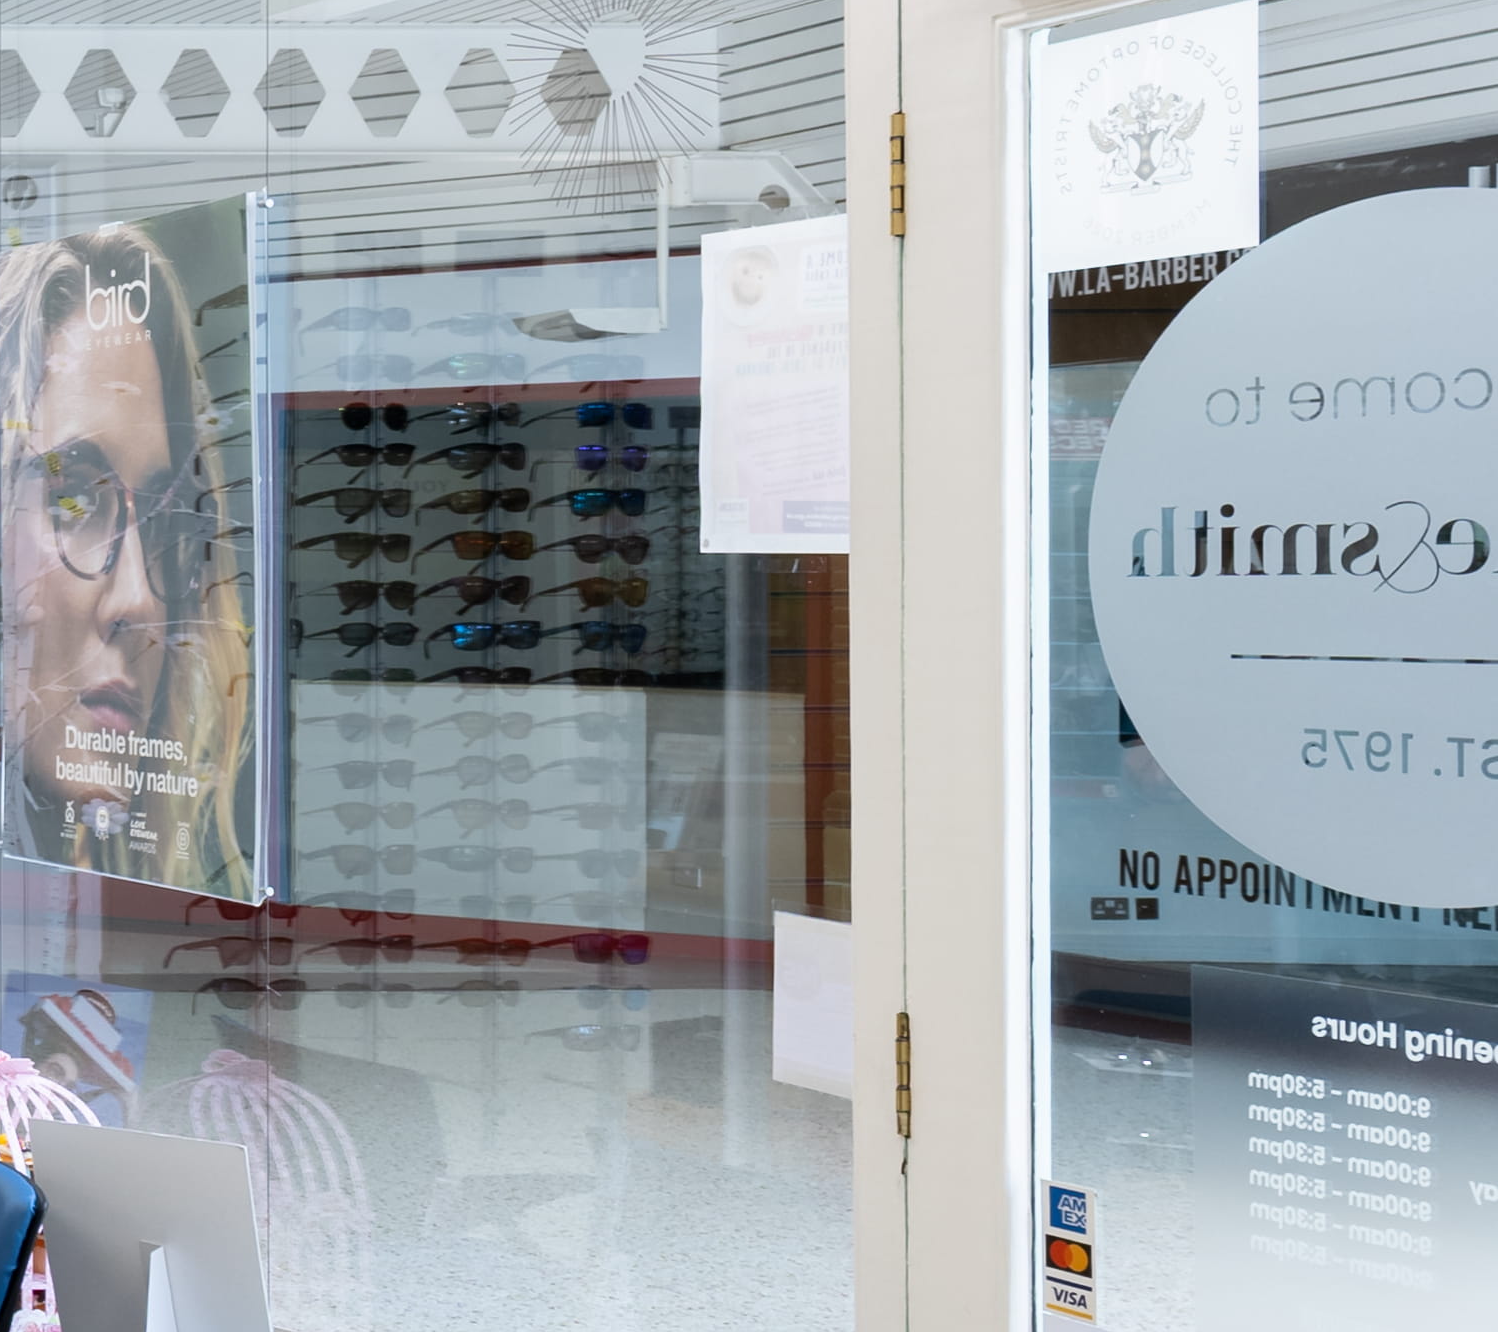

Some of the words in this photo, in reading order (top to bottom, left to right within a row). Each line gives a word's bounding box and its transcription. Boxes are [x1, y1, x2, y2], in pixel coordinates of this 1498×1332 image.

[85, 252, 152, 332] bird
[84, 330, 152, 351] EYEWEAR
[65, 725, 126, 755] Durable
[128, 730, 188, 766] frames,
[56, 755, 122, 788] beautiful
[124, 763, 145, 795] by
[146, 769, 198, 798] nature
[1120, 848, 1160, 891] NO
[1057, 1194, 1086, 1214] AM
[1062, 1209, 1087, 1228] EX
[1052, 1287, 1088, 1309] VISA
